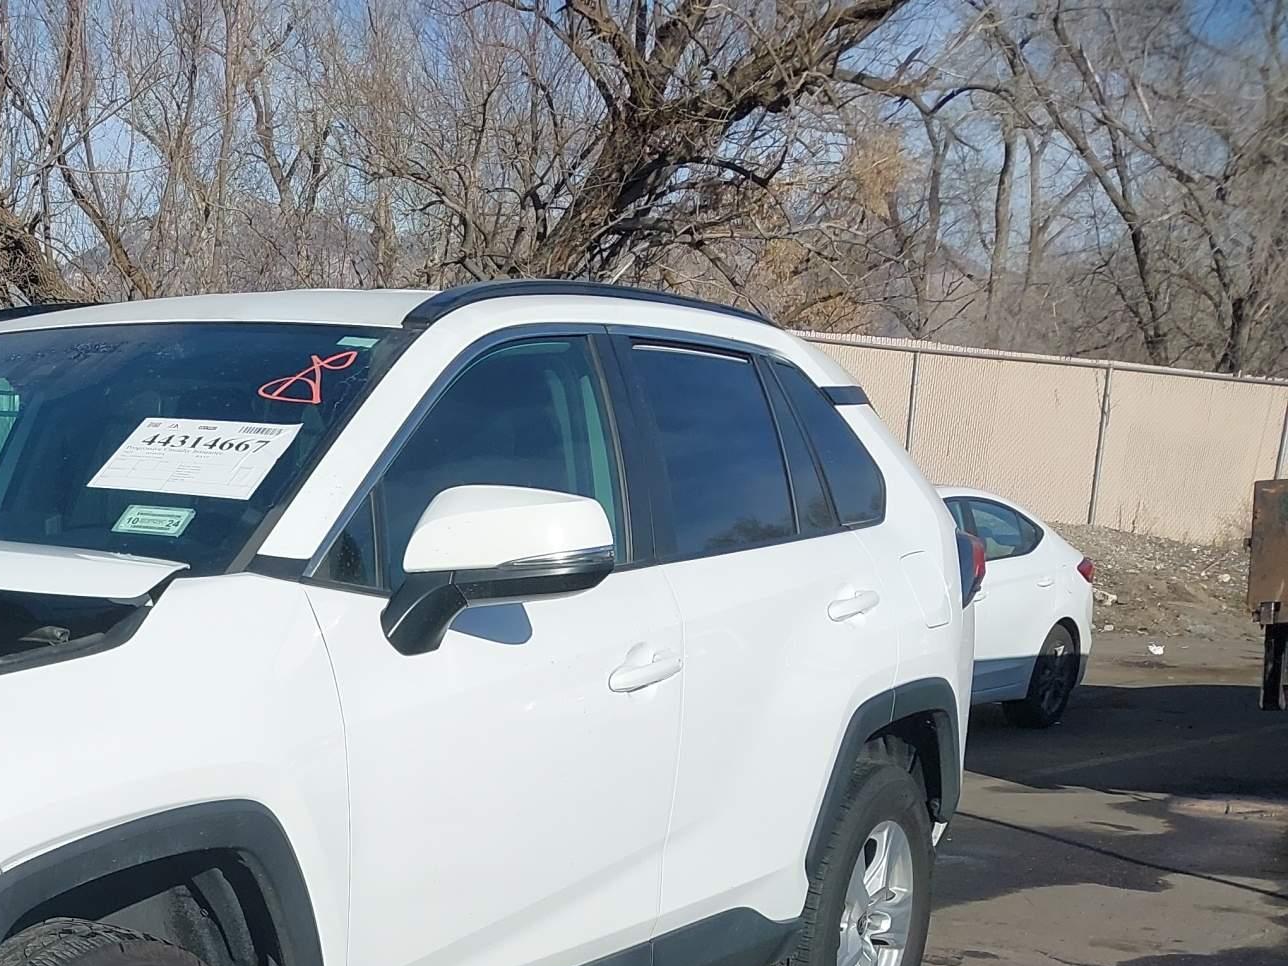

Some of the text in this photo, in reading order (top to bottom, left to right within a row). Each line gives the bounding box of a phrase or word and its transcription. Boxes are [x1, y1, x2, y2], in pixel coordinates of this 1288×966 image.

[141, 433, 272, 454] 44314667
[126, 516, 140, 525] 10
[165, 519, 182, 528] 24
